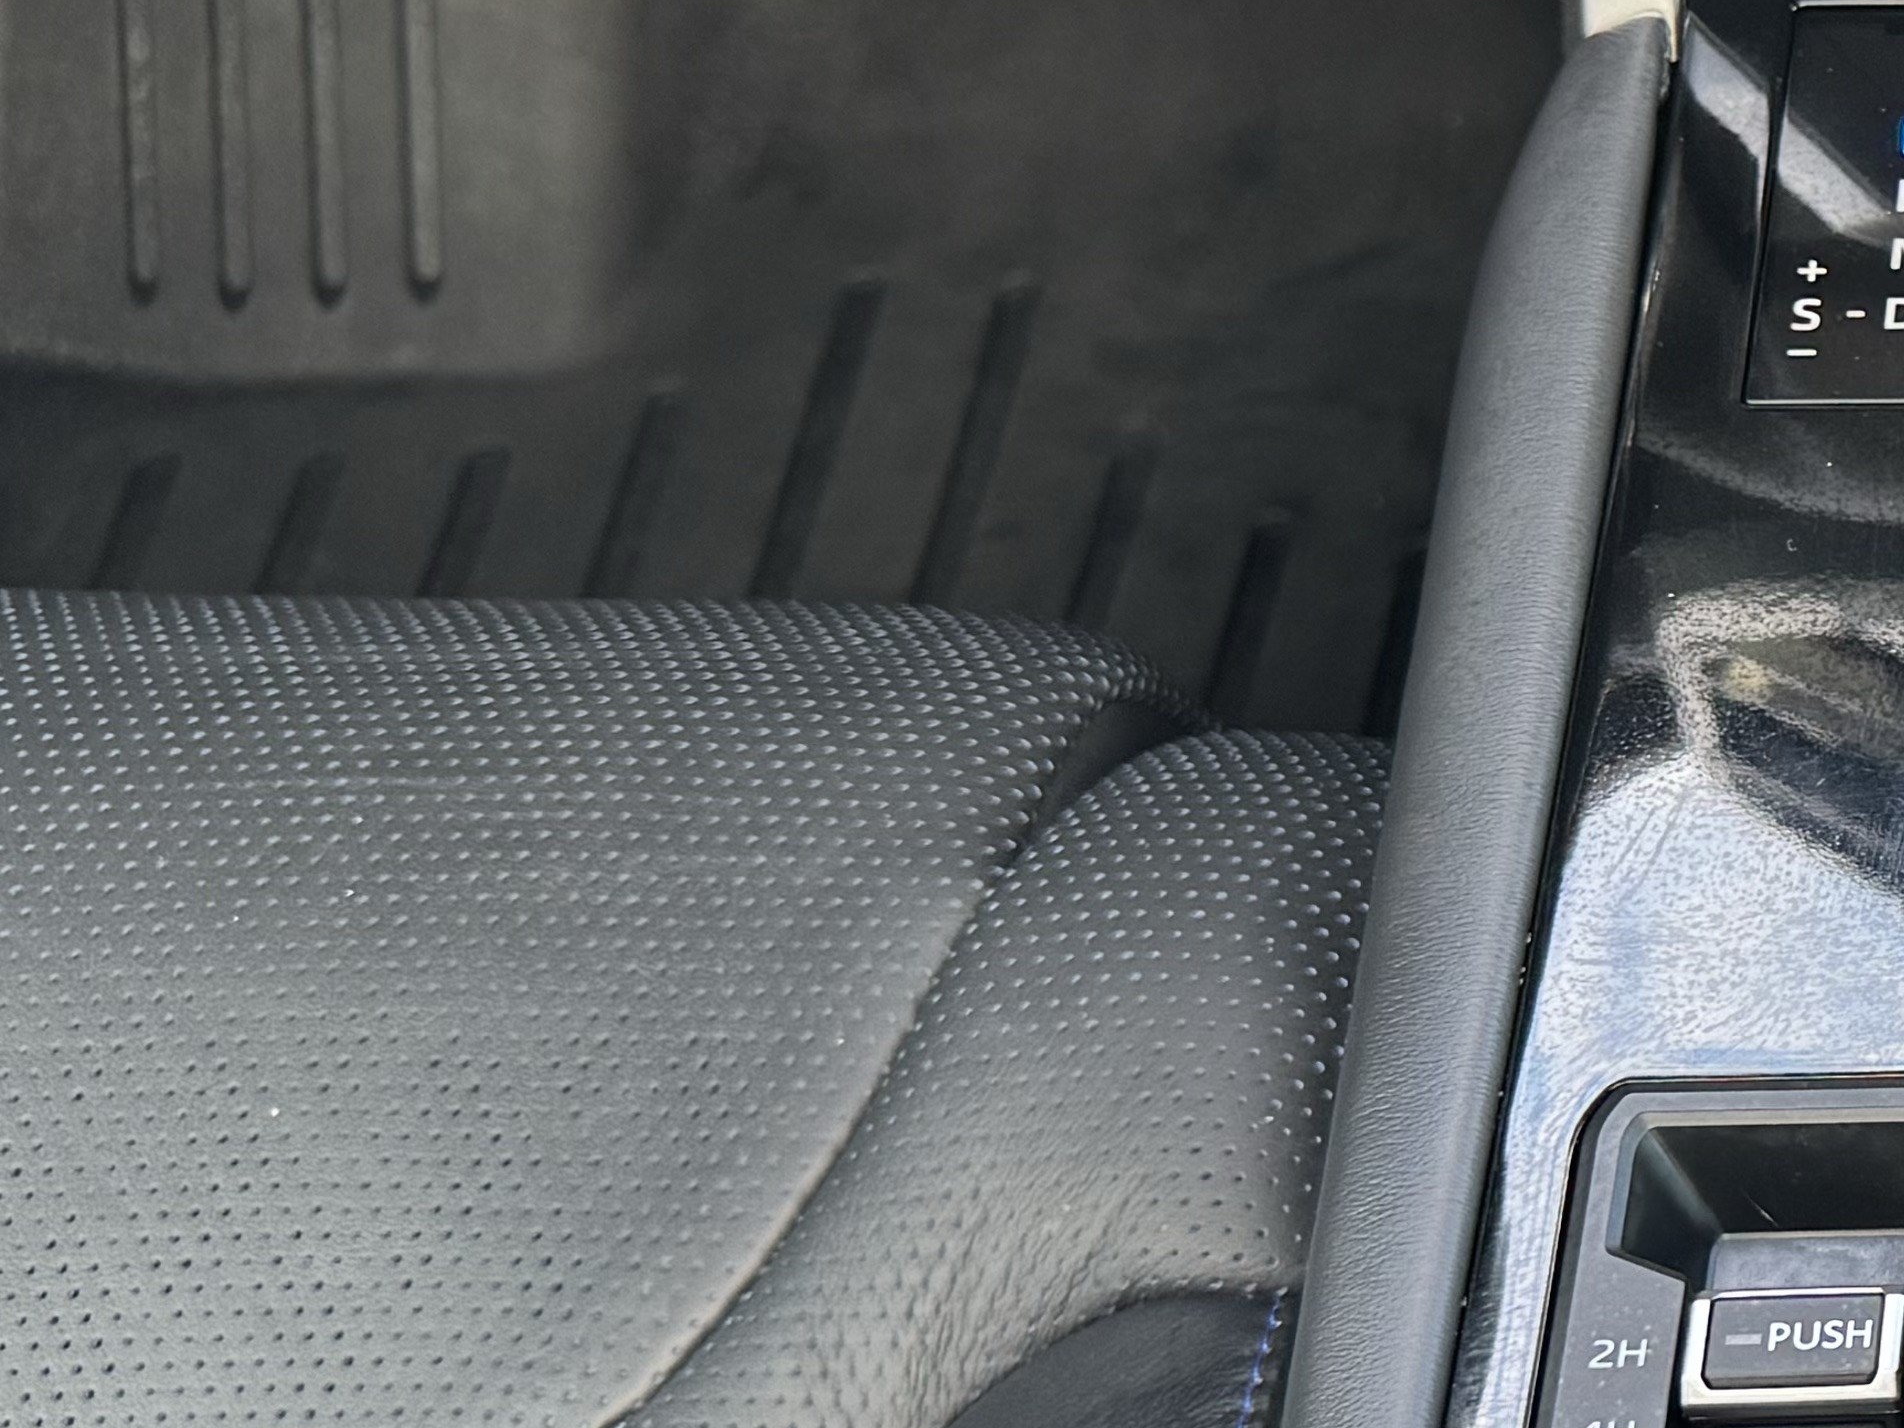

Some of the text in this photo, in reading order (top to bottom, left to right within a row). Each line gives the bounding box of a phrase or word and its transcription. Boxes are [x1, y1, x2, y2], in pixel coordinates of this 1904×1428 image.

[1790, 298, 1822, 332] S
[1767, 1316, 1874, 1354] PUSH
[1587, 1337, 1649, 1369] 2H
